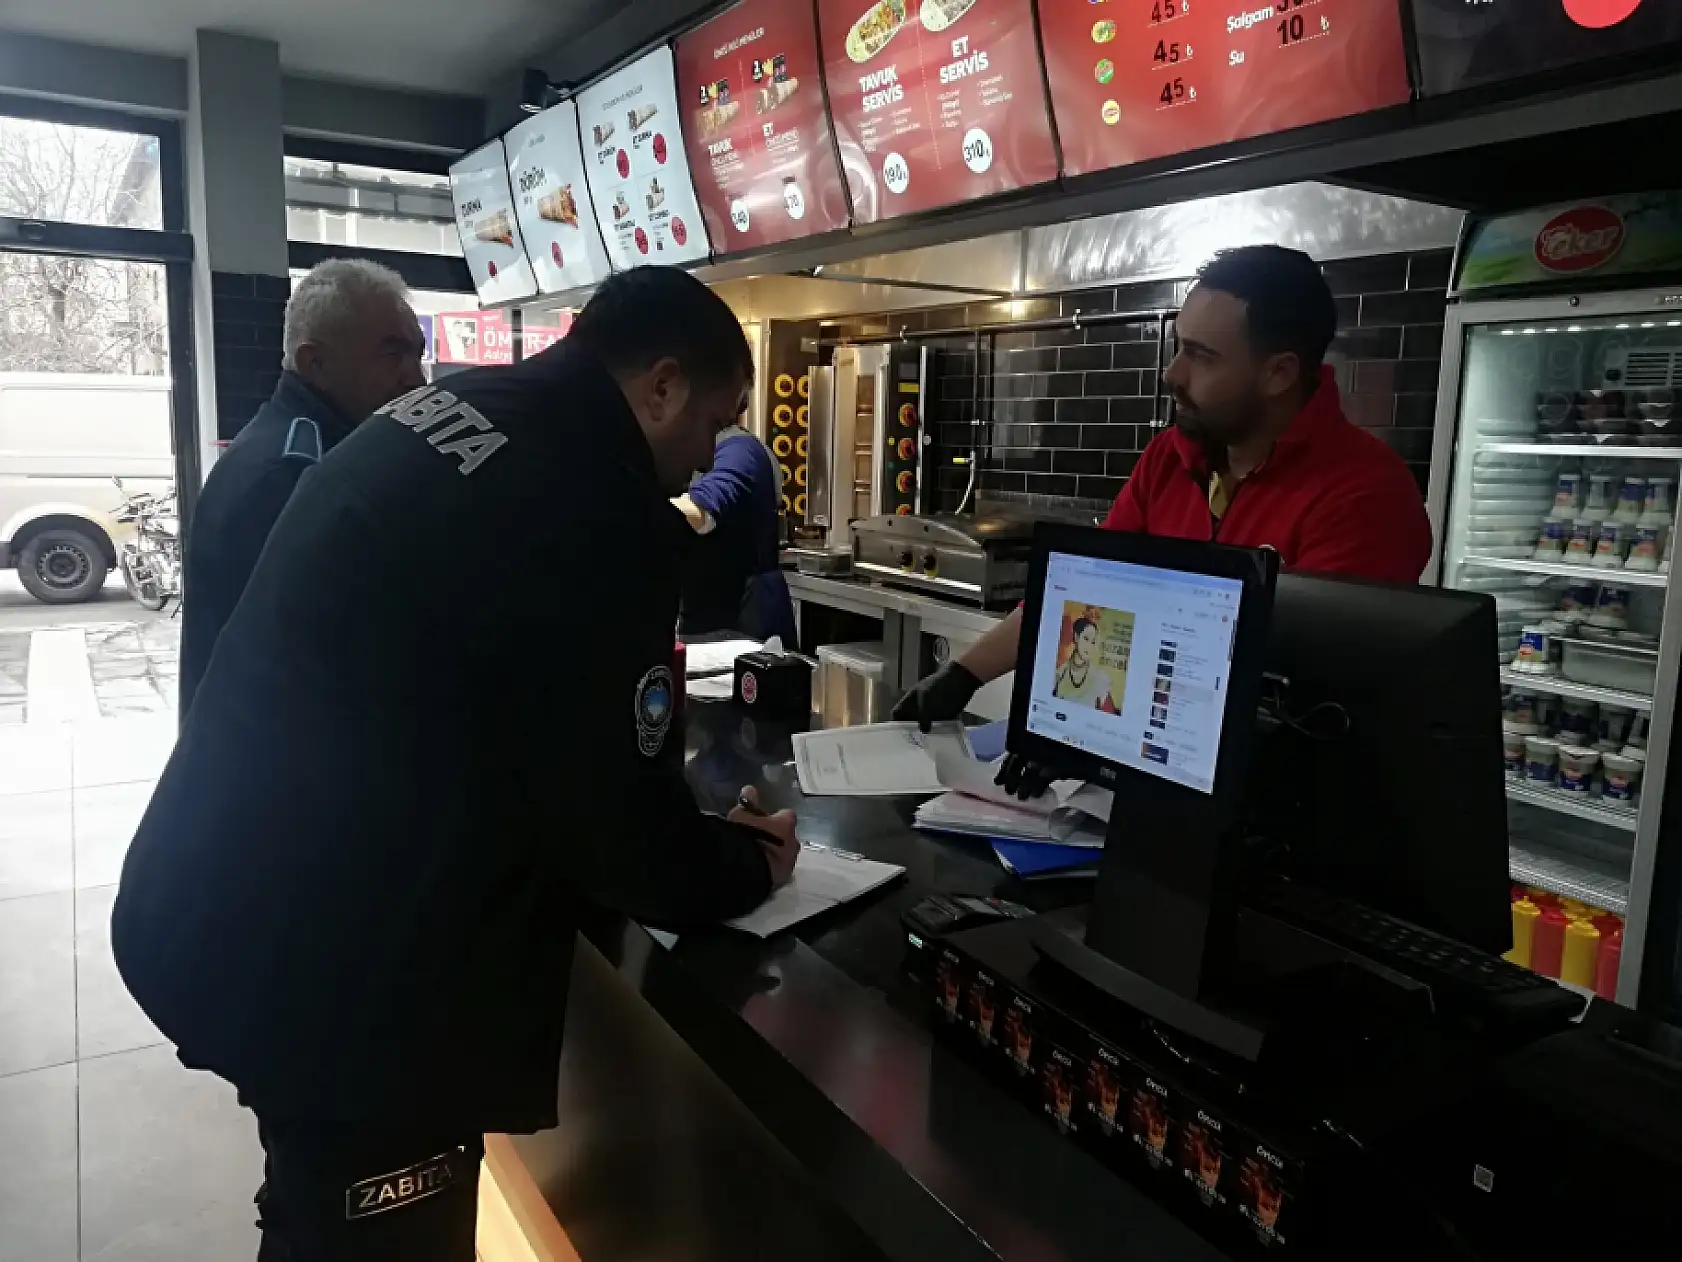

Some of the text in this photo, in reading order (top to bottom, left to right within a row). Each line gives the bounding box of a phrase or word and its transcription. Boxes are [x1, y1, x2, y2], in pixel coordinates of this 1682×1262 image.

[1226, 6, 1274, 33] Şalgam
[951, 35, 969, 57] ET
[1153, 40, 1180, 63] 45
[1228, 50, 1245, 66] Su
[1276, 14, 1304, 45] 10
[858, 64, 899, 92] TAVUK
[939, 50, 989, 84] SERVİS
[862, 84, 904, 112] SERVİS
[1160, 77, 1184, 105] 45
[763, 122, 774, 137] ET
